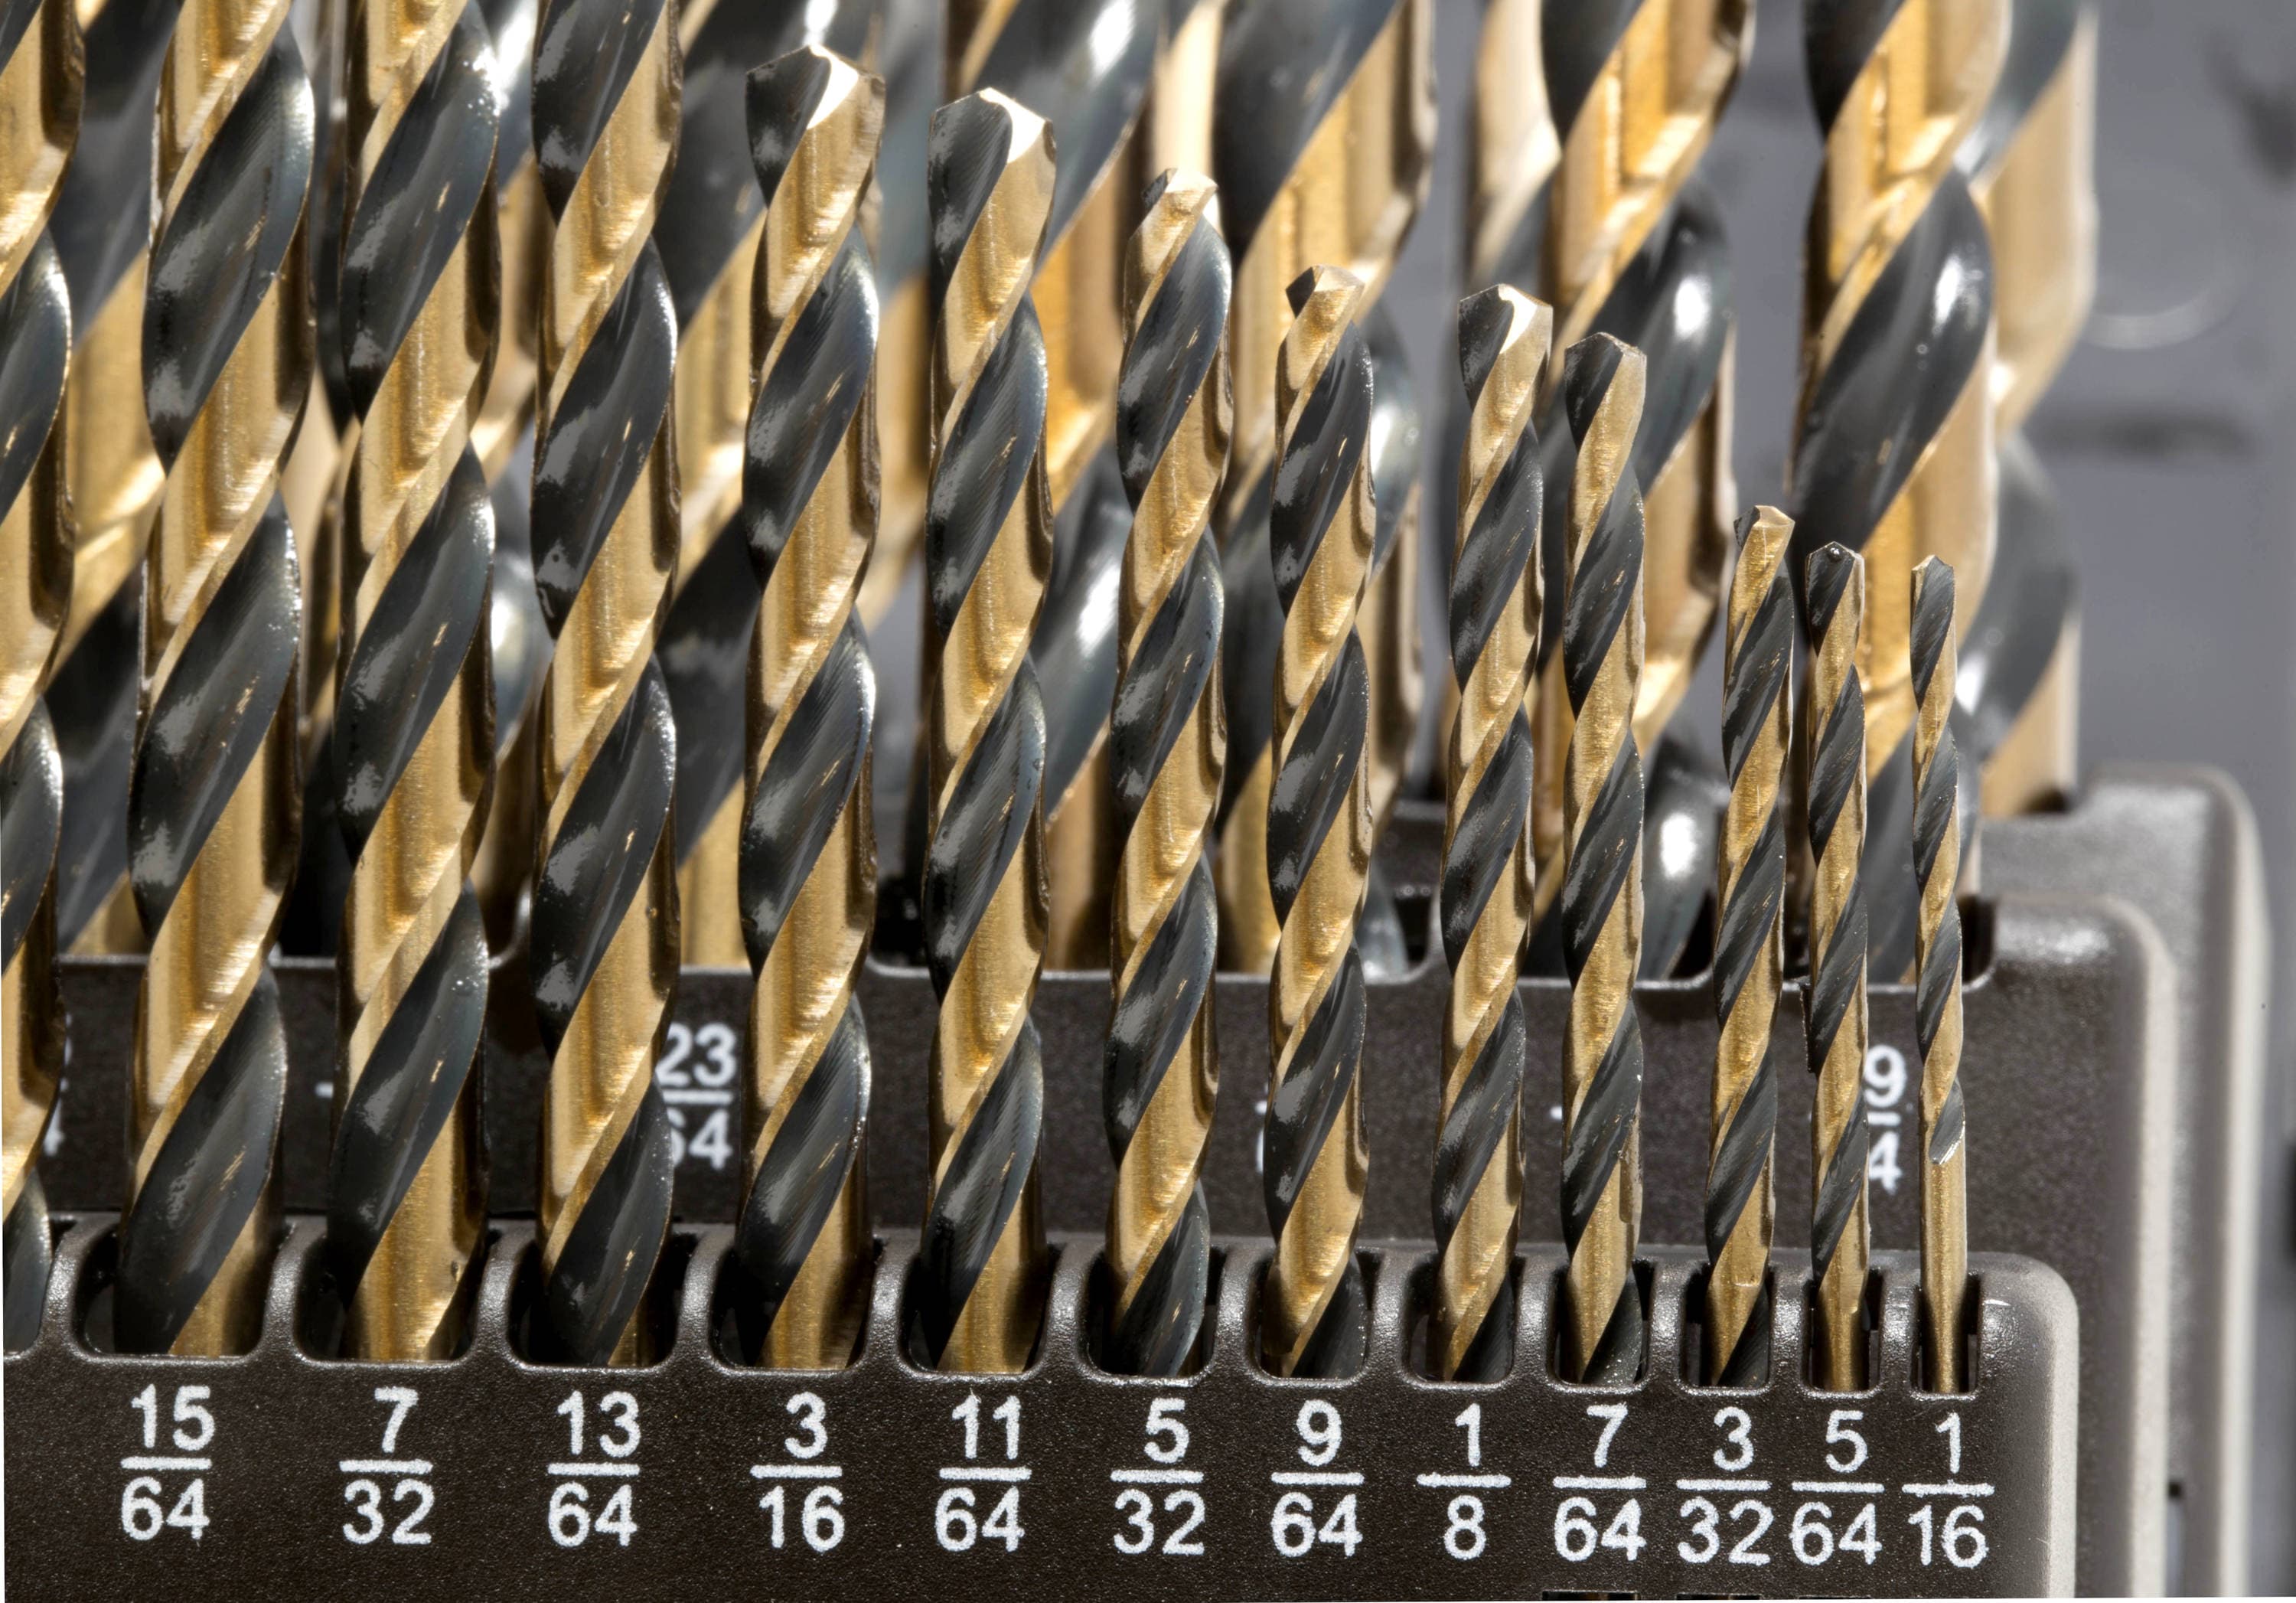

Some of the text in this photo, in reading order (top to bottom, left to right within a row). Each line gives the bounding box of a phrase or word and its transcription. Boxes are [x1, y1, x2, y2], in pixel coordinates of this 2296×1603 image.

[656, 1022, 736, 1087] 23
[131, 1383, 216, 1451] 15
[374, 1386, 419, 1453] 7
[557, 1390, 641, 1458] 13
[784, 1391, 828, 1459] 3
[951, 1391, 1022, 1460] 11
[1143, 1397, 1189, 1464] 5
[1296, 1399, 1342, 1467] 9
[1455, 1402, 1481, 1468] 1
[1587, 1402, 1629, 1468] 7
[1713, 1406, 1754, 1472] 3
[1825, 1409, 1869, 1474] 5
[1935, 1412, 1962, 1474] 1
[121, 1476, 211, 1540] 64
[342, 1478, 435, 1545] 32
[548, 1481, 638, 1547] 64
[759, 1485, 845, 1552] 16
[935, 1486, 1025, 1552] 64
[1114, 1488, 1206, 1556] 32
[1270, 1492, 1363, 1557] 64
[1442, 1494, 1487, 1561] 8
[1554, 1497, 1647, 1562] 64
[1677, 1496, 1774, 1566] 32
[1789, 1501, 1883, 1566] 64
[1908, 1504, 1990, 1569] 16
